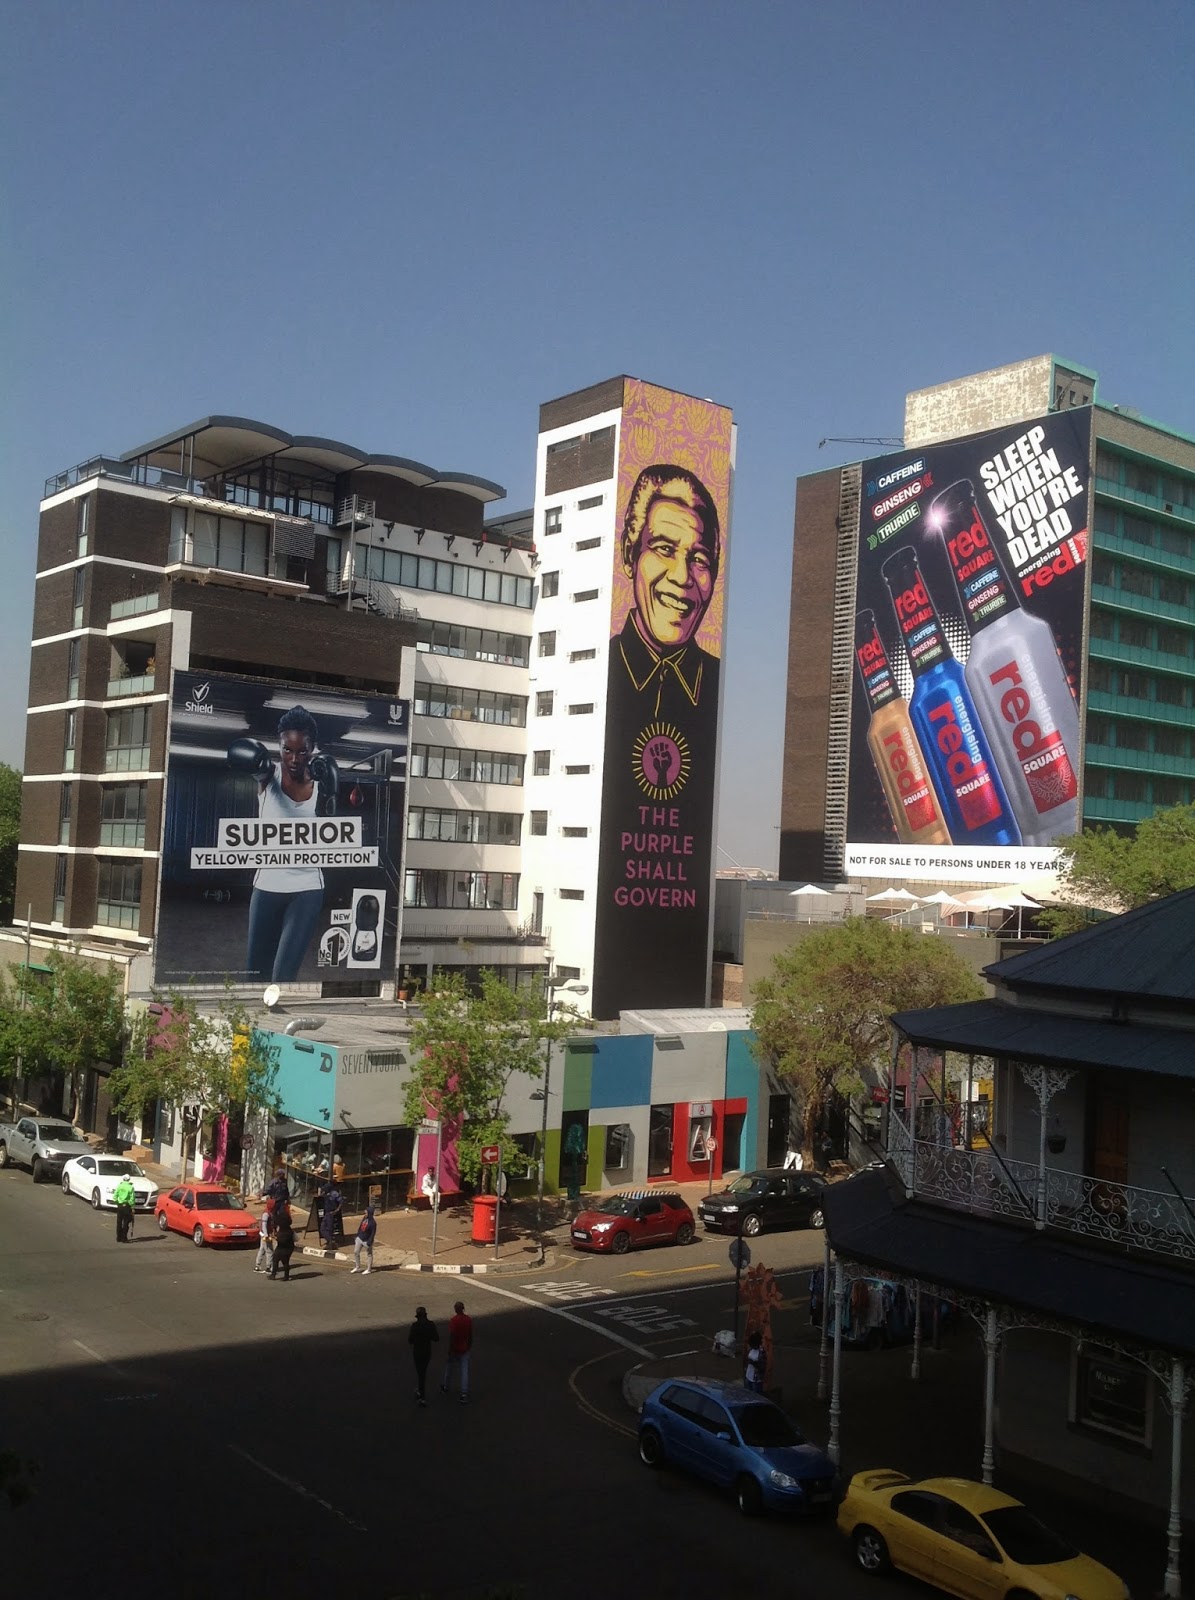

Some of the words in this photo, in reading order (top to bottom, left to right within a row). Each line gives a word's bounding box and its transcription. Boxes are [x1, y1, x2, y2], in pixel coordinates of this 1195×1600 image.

[979, 425, 1046, 490] SLEEP
[878, 460, 924, 488] CAFFEINE
[987, 447, 1062, 516] WHEN
[874, 482, 922, 517] GINSENG
[996, 465, 1084, 541] YOU'RE
[878, 504, 919, 539] TAURINE
[948, 506, 989, 567] red
[1006, 507, 1073, 568] DEAD
[957, 550, 995, 582] SQUARE
[1018, 546, 1062, 578] energising
[1020, 541, 1075, 597] red
[895, 569, 929, 620] red
[968, 585, 999, 610] GINSENG
[903, 606, 934, 633] SQUARE
[858, 627, 884, 668] red
[911, 637, 938, 657] GINSENG
[184, 701, 213, 714] Shield
[989, 660, 1062, 762] red
[928, 701, 988, 788] red
[954, 695, 983, 764] energising
[883, 731, 927, 798] red
[1023, 745, 1066, 775] SQUARE
[903, 788, 930, 806] SQUARE
[956, 773, 991, 798] SQUARE
[638, 805, 680, 828] THE
[225, 822, 355, 847] SUPERIOR
[621, 832, 694, 855] PURPLE
[195, 853, 291, 866] YELLOW-STAIN
[625, 859, 687, 881] SHALL
[849, 856, 867, 864] NOT
[869, 856, 887, 865] FOR
[889, 857, 911, 866] SALE
[914, 858, 926, 866] TO
[929, 859, 974, 868] PERSONS
[976, 860, 1012, 869] UNDER
[1014, 861, 1026, 869] 18
[614, 886, 696, 908] GOVERN
[333, 913, 351, 921] NEW
